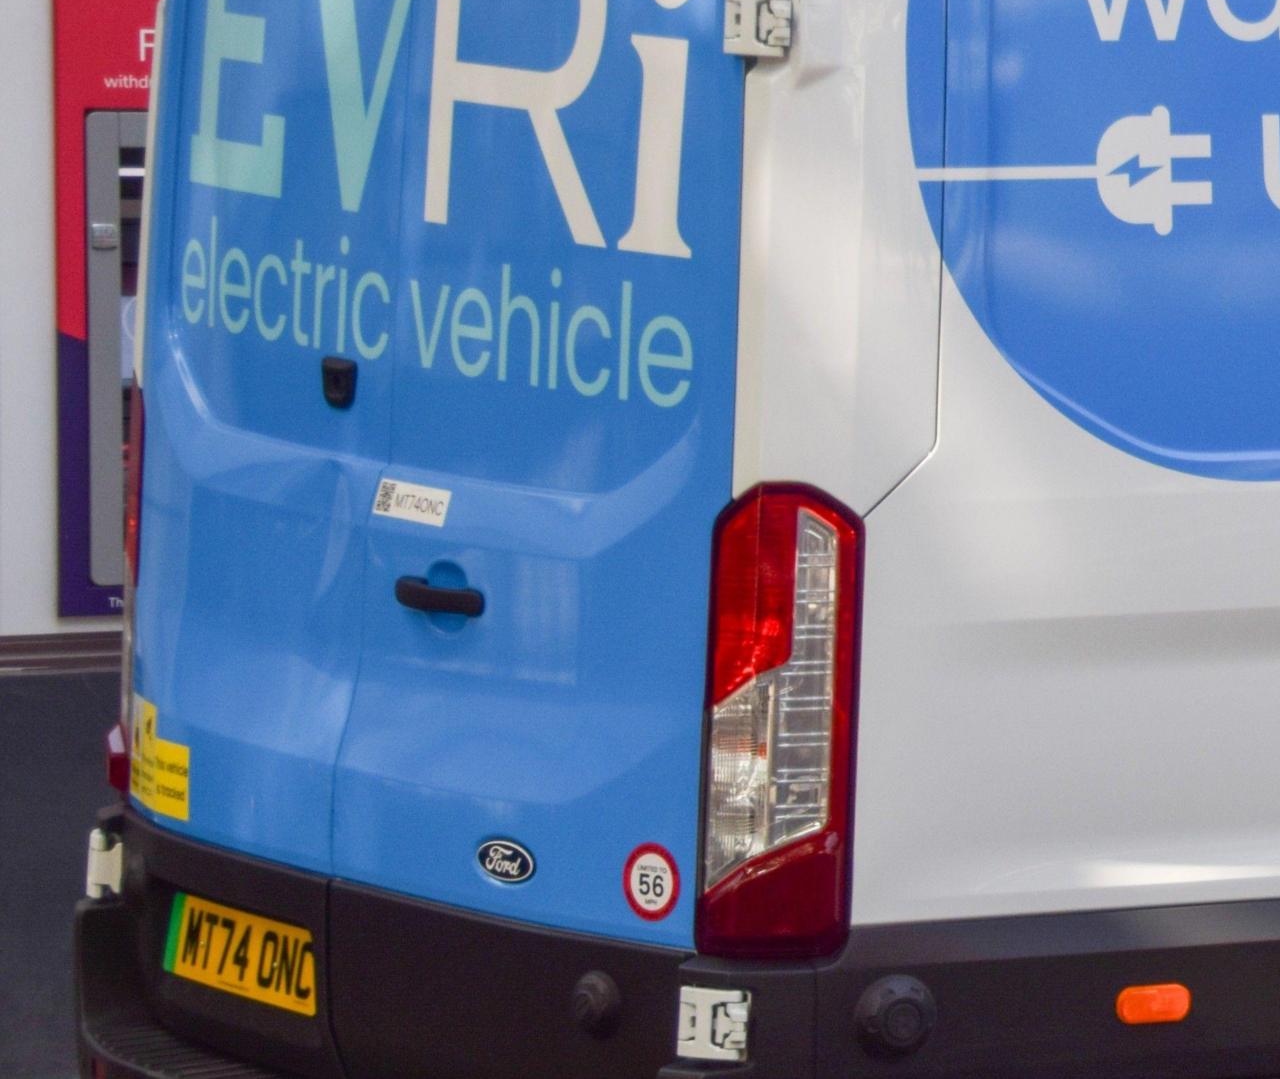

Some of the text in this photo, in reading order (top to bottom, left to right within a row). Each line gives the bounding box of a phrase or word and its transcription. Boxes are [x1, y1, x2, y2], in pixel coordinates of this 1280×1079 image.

[180, 217, 693, 408] electric vehicle
[395, 492, 445, 517] MT74ONC
[485, 845, 521, 875] Ford
[639, 873, 664, 897] 56
[182, 907, 314, 1000] MT74 ONC
